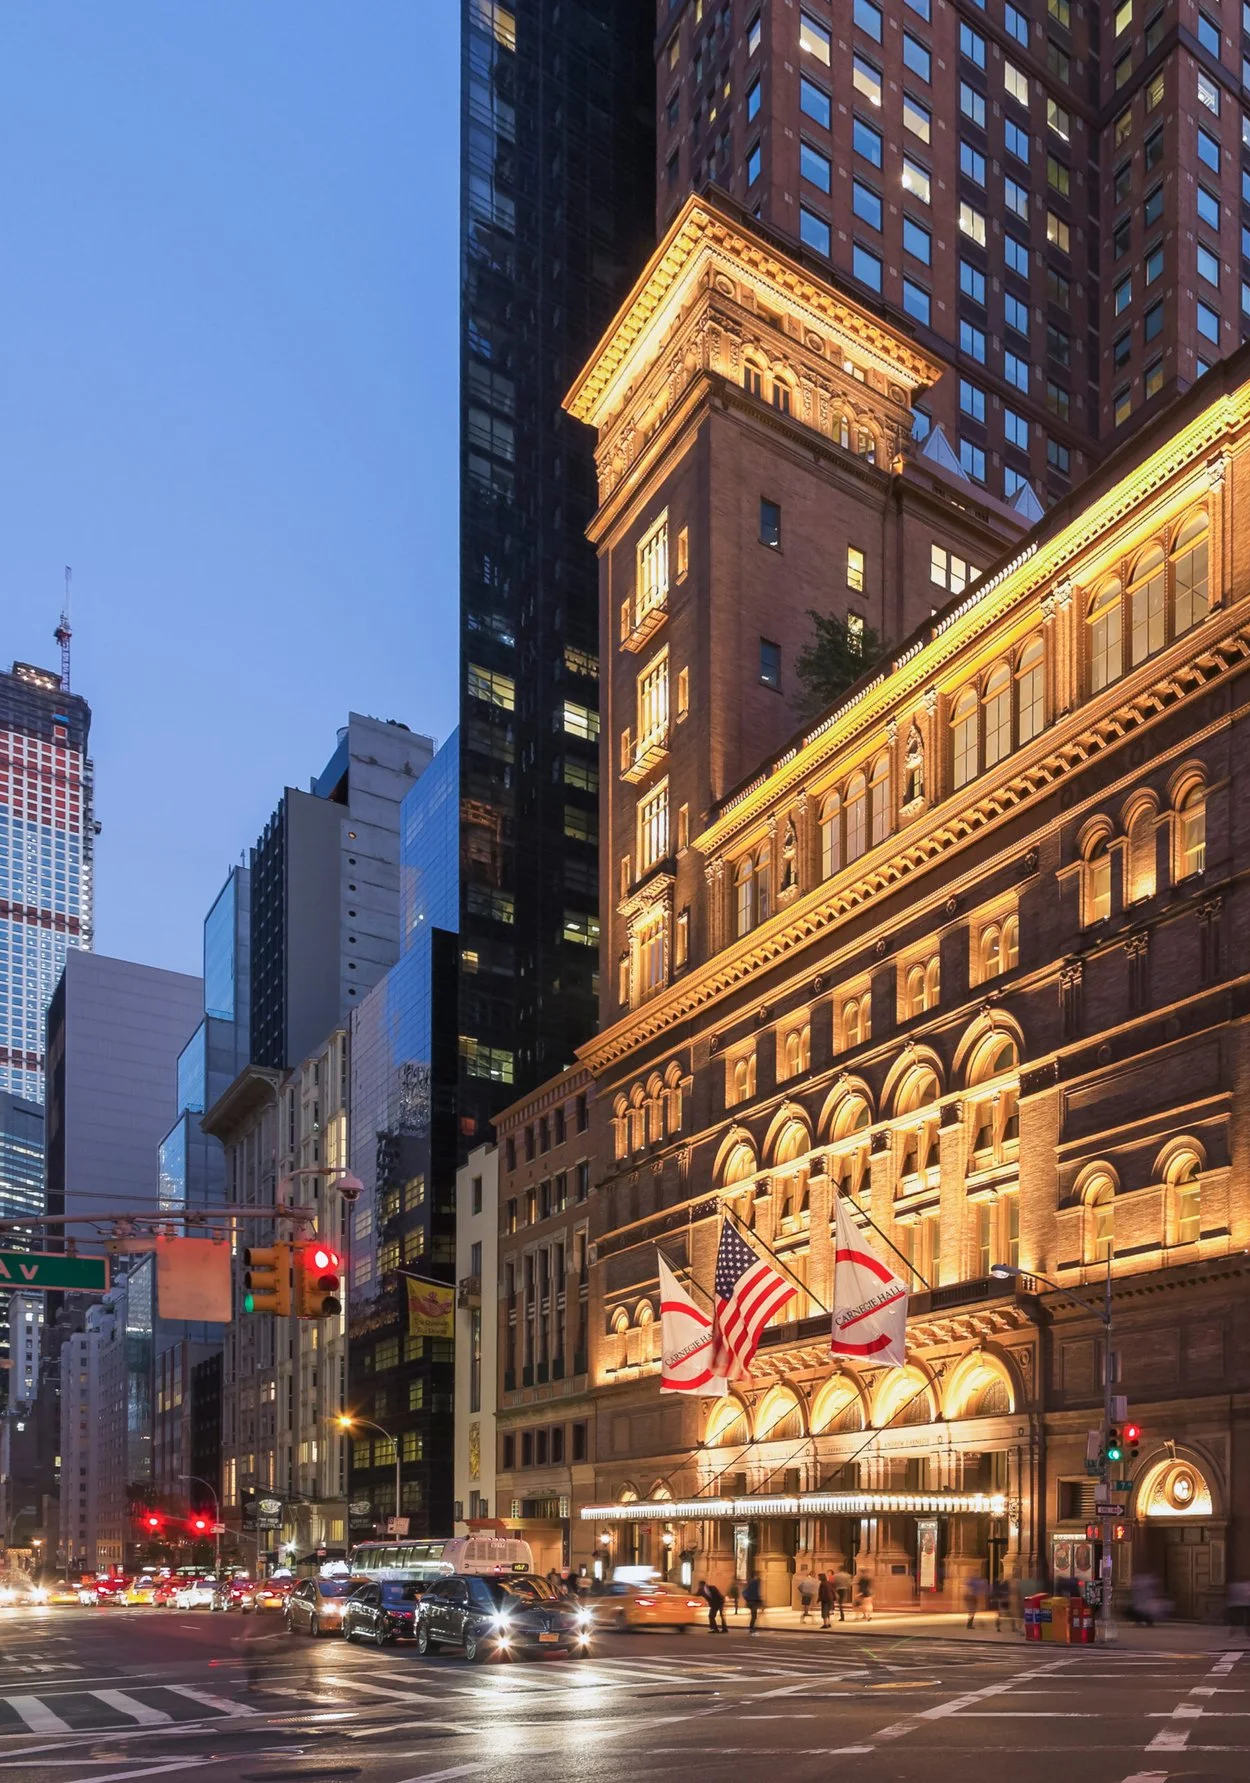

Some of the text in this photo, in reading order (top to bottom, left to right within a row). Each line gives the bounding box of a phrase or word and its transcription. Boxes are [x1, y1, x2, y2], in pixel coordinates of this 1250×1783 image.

[835, 1285, 904, 1326] CARNEGIE HALL
[665, 1339, 700, 1366] CARNEGIE
